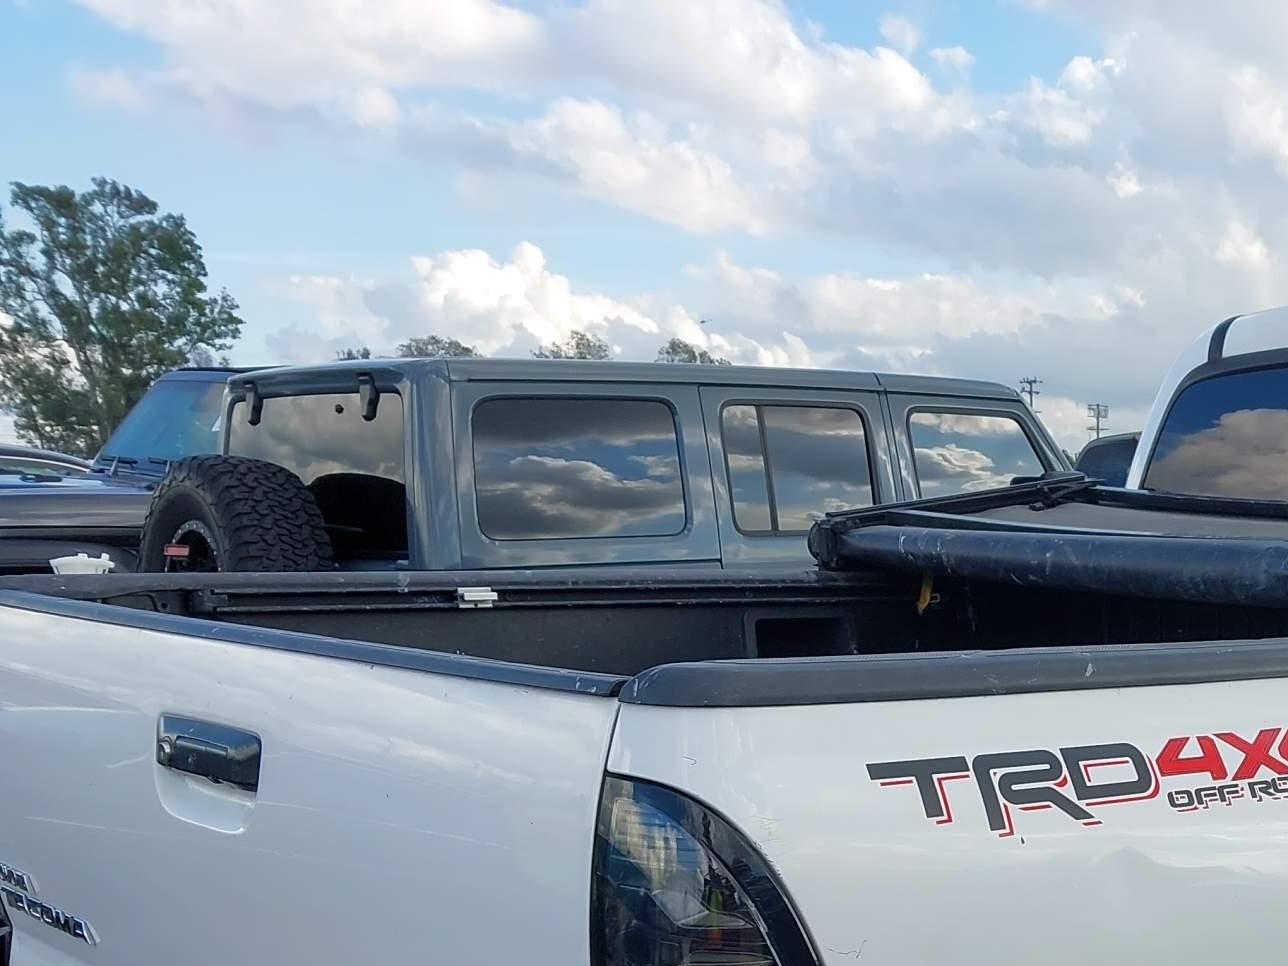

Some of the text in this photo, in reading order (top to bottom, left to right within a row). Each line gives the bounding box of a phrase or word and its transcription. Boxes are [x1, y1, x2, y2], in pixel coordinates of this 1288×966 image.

[865, 741, 1160, 837] TRD
[1168, 784, 1244, 813] OFF
[0, 884, 97, 945] TACOMA
